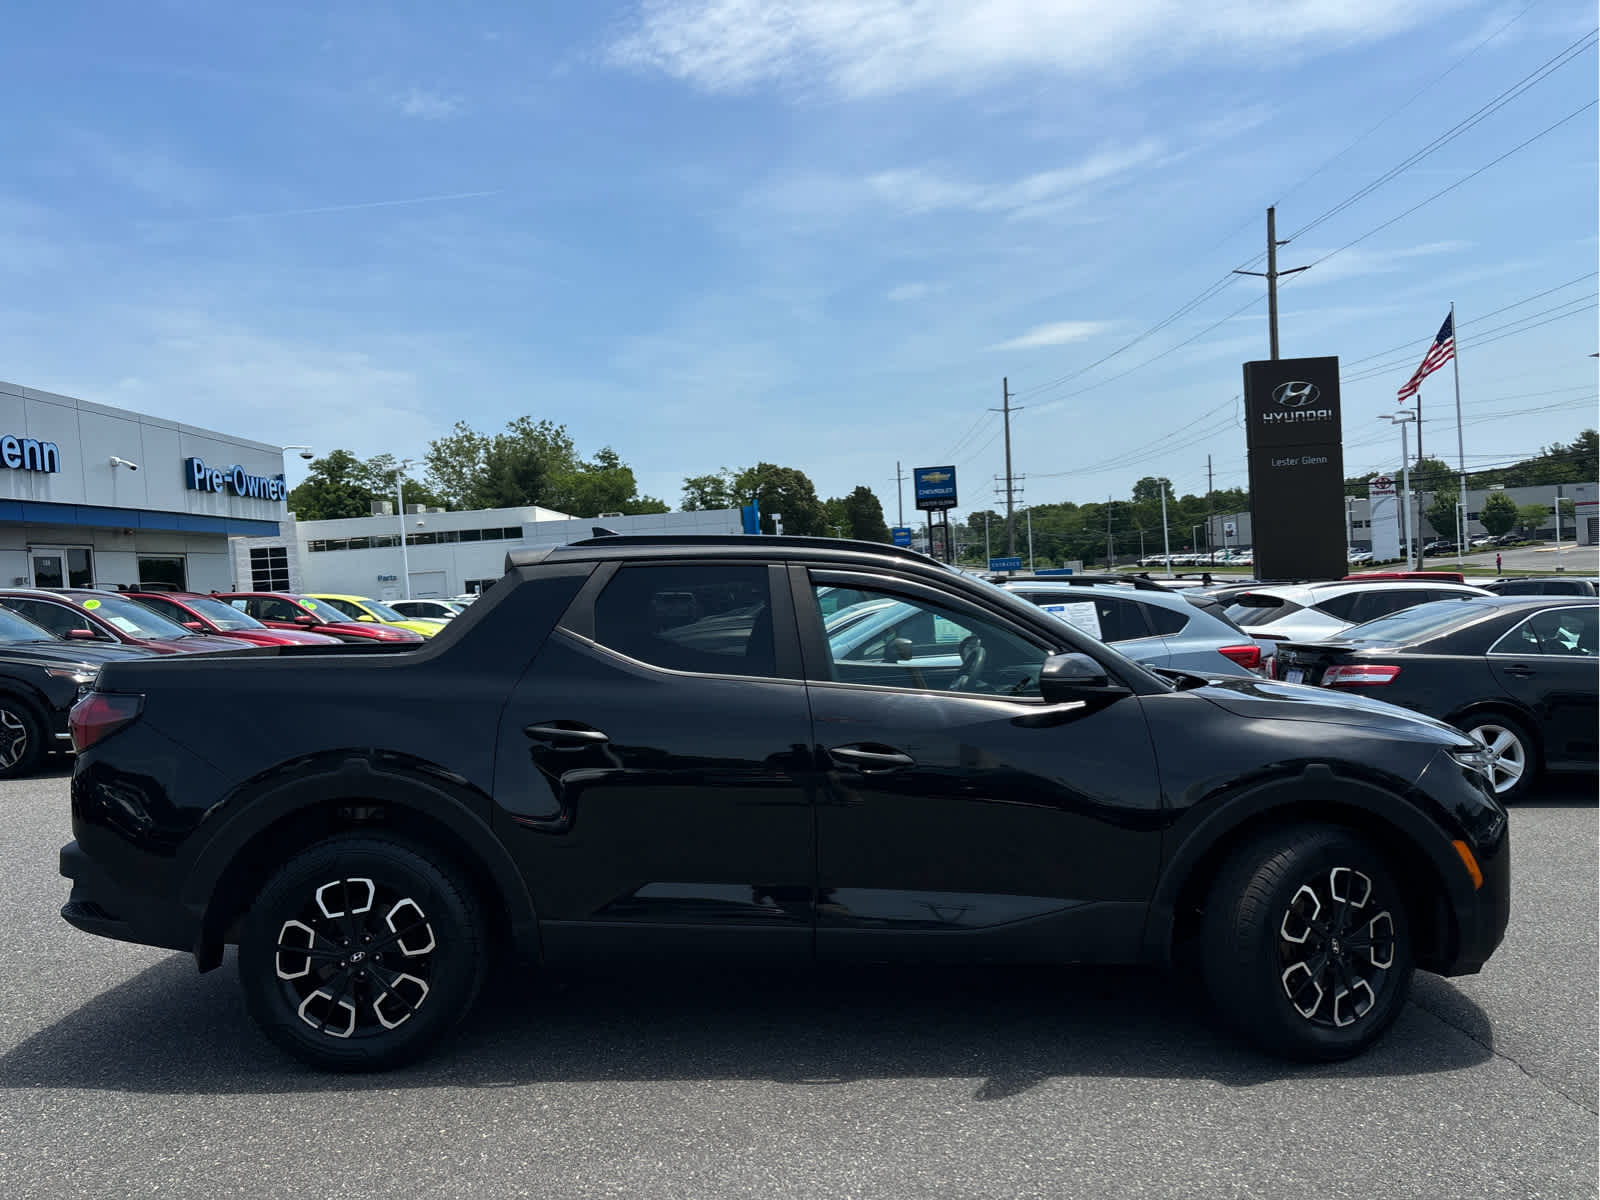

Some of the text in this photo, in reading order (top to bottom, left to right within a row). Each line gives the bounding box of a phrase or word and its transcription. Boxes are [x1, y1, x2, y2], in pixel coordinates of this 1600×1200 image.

[1263, 409, 1332, 424] HYUNDAI
[1, 435, 60, 473] enn
[1271, 456, 1328, 467] Lester Glenn
[188, 457, 287, 501] Pre-Owned
[918, 487, 953, 496] CHEVROLET
